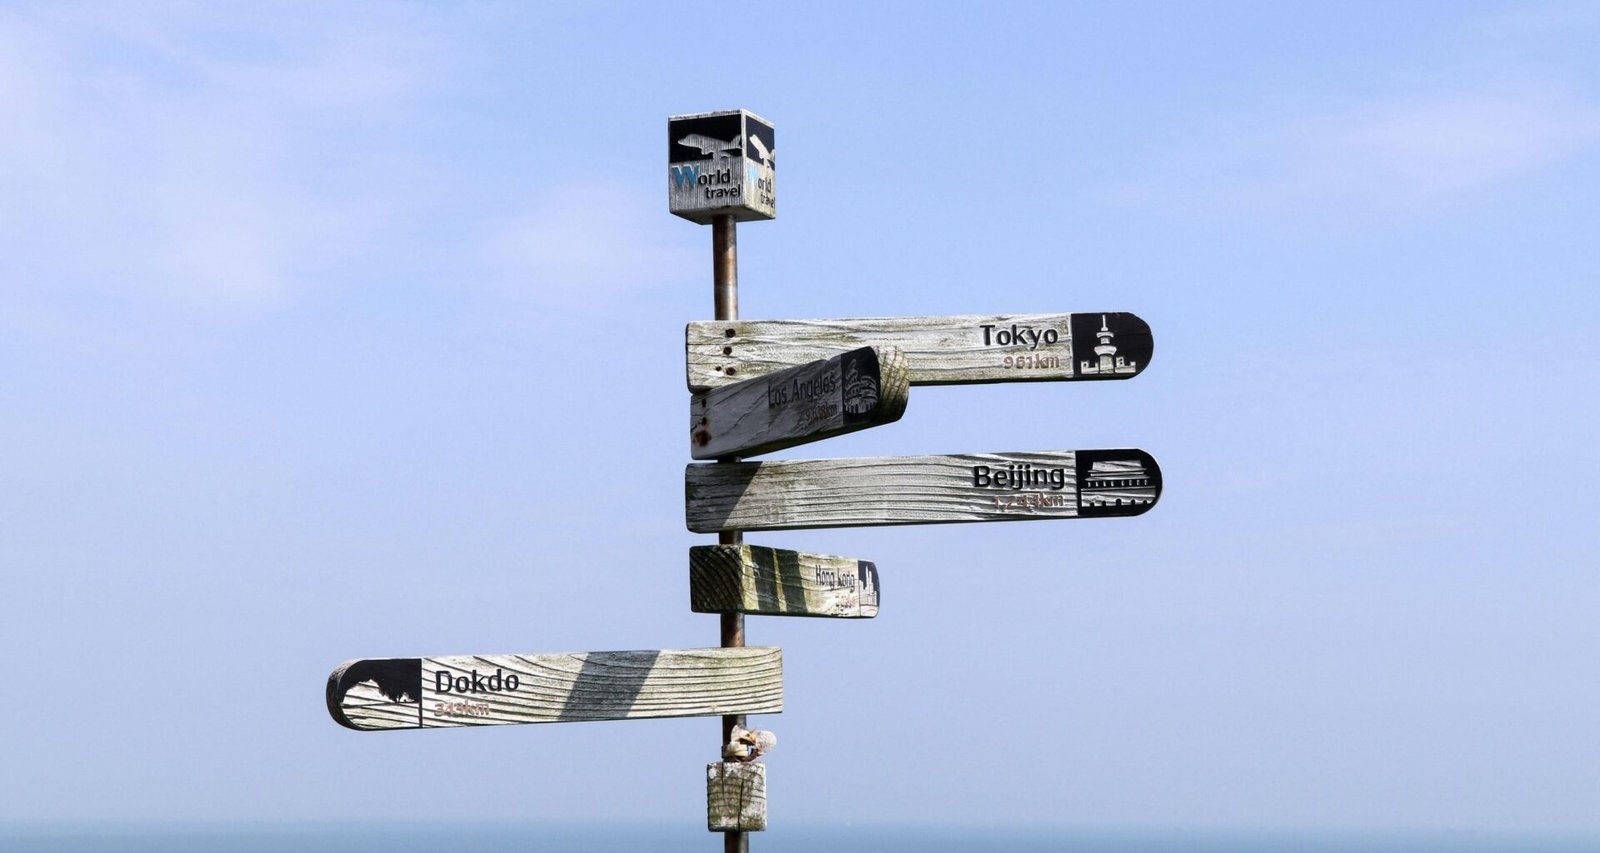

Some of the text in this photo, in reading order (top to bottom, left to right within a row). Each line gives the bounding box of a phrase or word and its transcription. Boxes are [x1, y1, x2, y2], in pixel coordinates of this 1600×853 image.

[672, 163, 731, 190] World
[706, 184, 741, 199] travel
[980, 324, 1059, 349] Tokyo
[1003, 353, 1060, 369] 961km
[768, 369, 837, 408] Los Angeles
[973, 463, 1066, 490] Beijing
[815, 564, 835, 591] Hong
[435, 668, 519, 694] Dokdo
